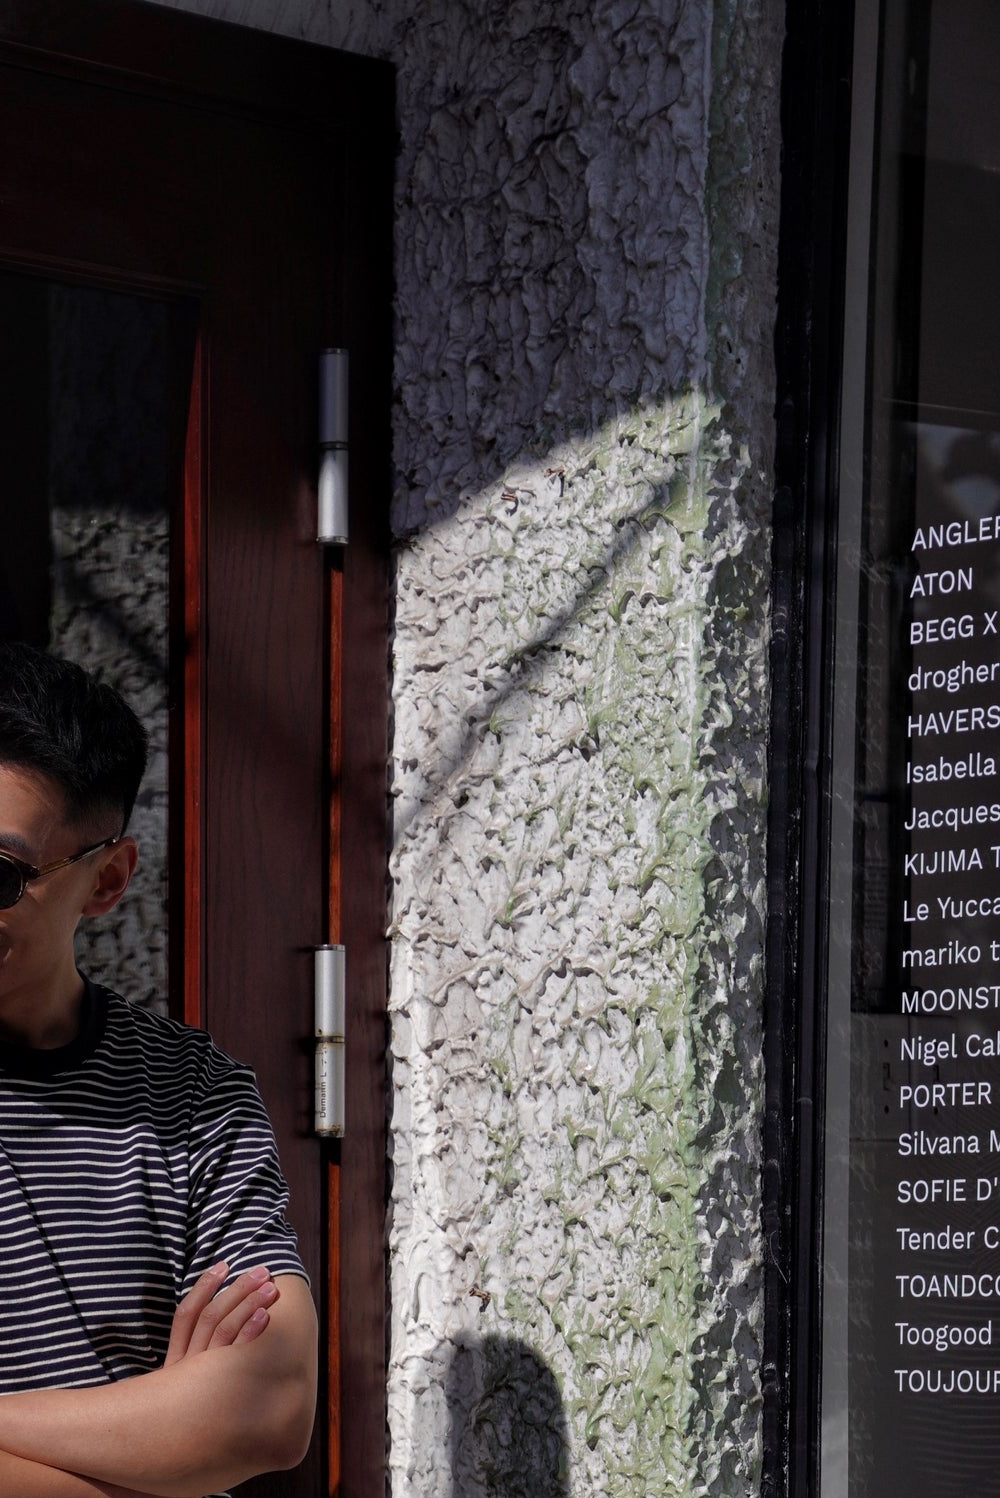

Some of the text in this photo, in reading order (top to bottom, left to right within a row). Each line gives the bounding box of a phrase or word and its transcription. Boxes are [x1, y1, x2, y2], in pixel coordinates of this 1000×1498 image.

[909, 567, 973, 599] ATON
[910, 610, 998, 645] BEGG X
[907, 660, 1000, 693] drogher
[907, 704, 1000, 738] HAVERS
[906, 752, 997, 784] Isabella
[904, 803, 1000, 832] Jacques
[904, 847, 983, 876] KIJIMA
[903, 900, 930, 922] Le
[902, 939, 1000, 968] mariko t
[900, 1032, 958, 1067] Nigel
[899, 1081, 992, 1109] PORTER
[897, 1130, 981, 1156] Silvana
[897, 1178, 967, 1204] SOFIE
[896, 1224, 1000, 1251] Tender C
[894, 1319, 992, 1352] Toogood
